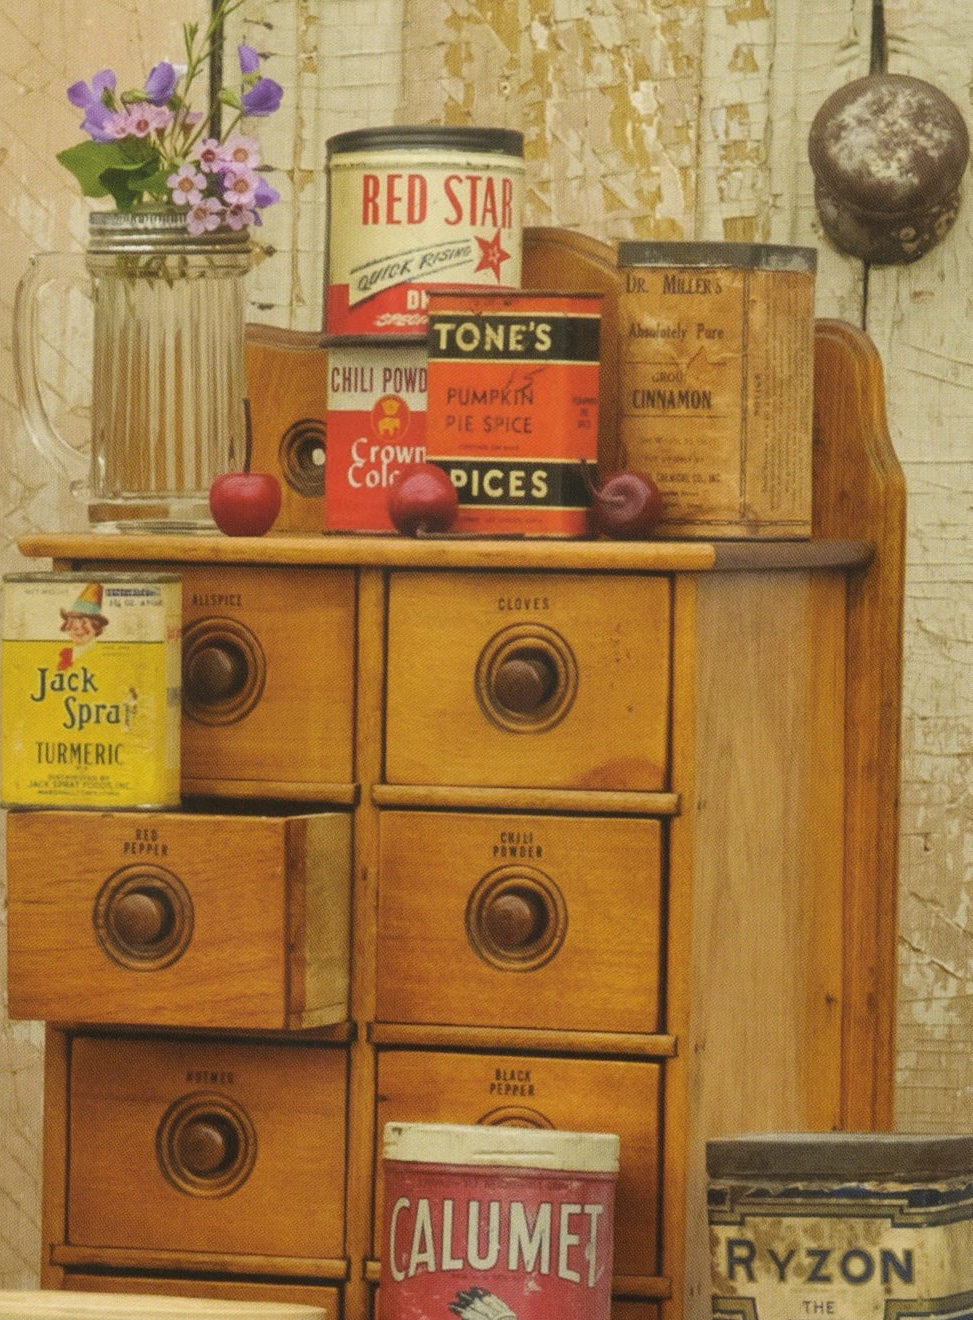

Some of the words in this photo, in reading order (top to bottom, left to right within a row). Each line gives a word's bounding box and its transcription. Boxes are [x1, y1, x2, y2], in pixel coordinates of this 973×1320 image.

[362, 174, 427, 226] RED
[444, 175, 513, 229] STAR
[357, 258, 413, 292] QUICK
[419, 246, 472, 270] RISING
[434, 321, 552, 351] TONE'S
[696, 322, 724, 340] Pure
[331, 367, 374, 393] CHILI
[446, 387, 534, 406] PUMPKIN
[632, 389, 711, 409] CINNAMON
[445, 416, 473, 433] PIE
[484, 416, 532, 434] SPICE
[351, 437, 427, 467] Crown
[498, 597, 550, 610] CLOVES
[30, 666, 98, 702] Jack
[36, 742, 125, 765] TURMERIC
[136, 829, 157, 841] RED
[501, 832, 533, 843] CHILI
[124, 842, 168, 856] PEPPER
[493, 845, 542, 857] POWDER
[495, 1068, 531, 1081] BLACK
[489, 1083, 534, 1096] PEPPER
[390, 1197, 604, 1288] CALUMET
[727, 1238, 914, 1285] RYZON
[802, 1301, 835, 1314] THE
